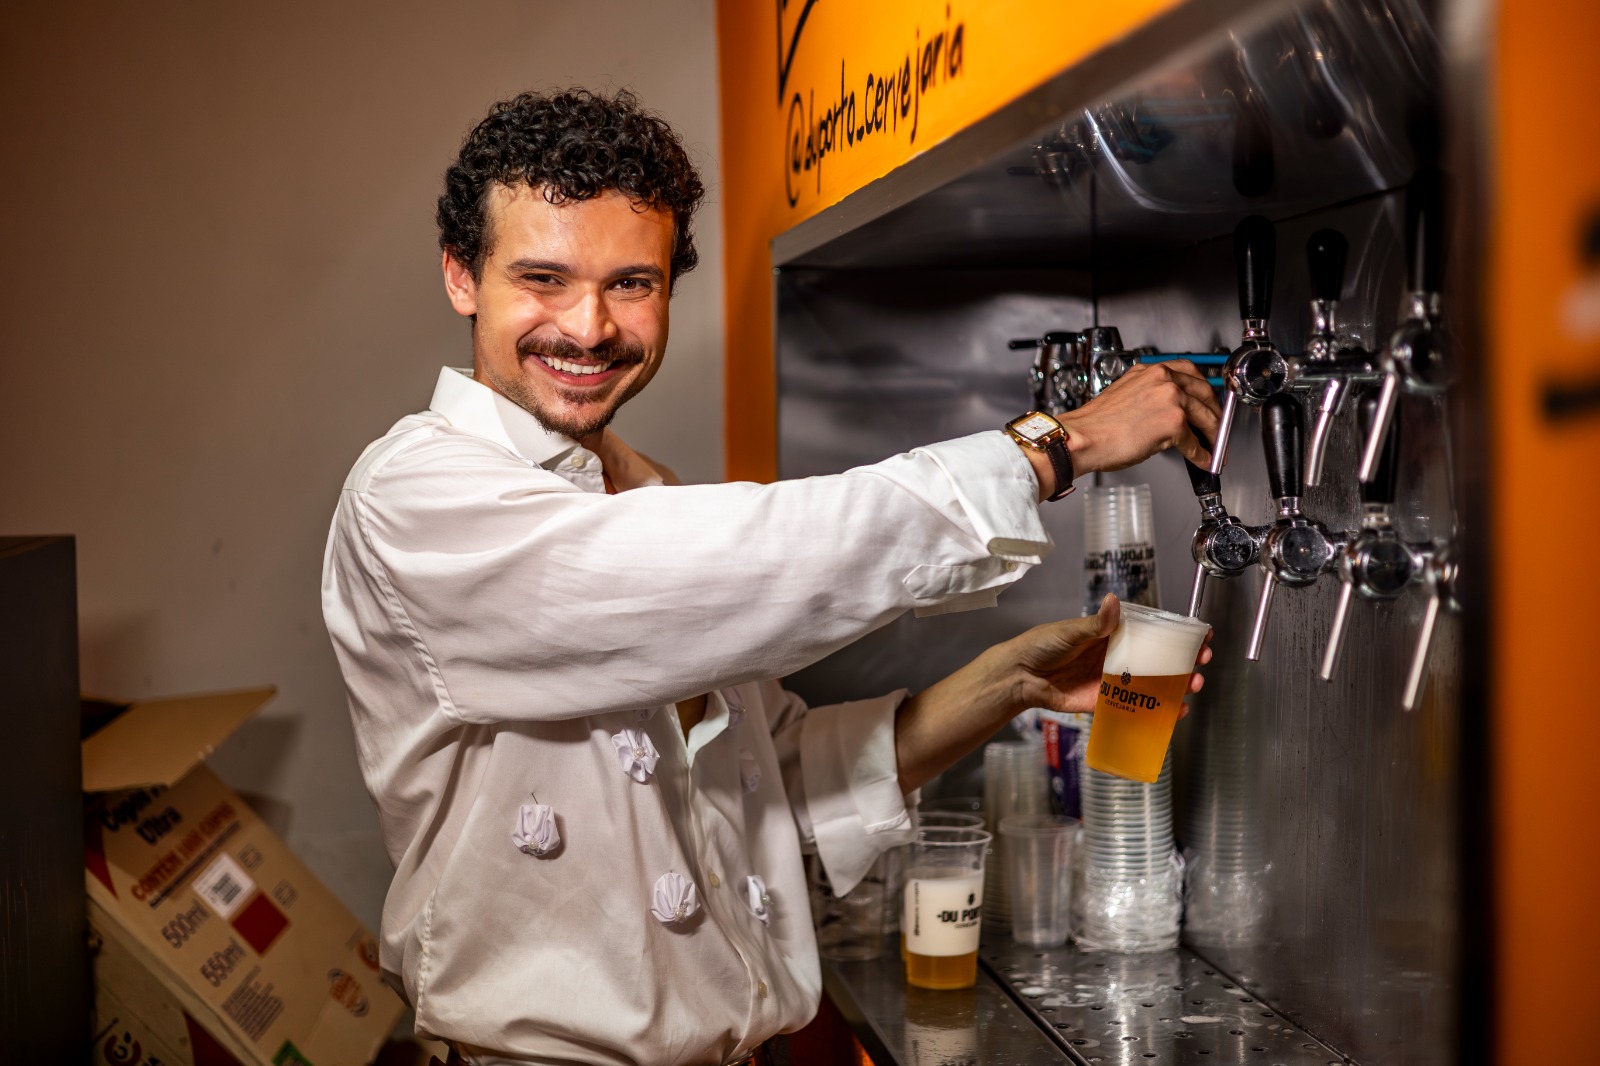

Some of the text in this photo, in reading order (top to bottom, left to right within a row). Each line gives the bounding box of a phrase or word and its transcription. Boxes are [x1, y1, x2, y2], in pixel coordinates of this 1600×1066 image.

[1105, 699, 1136, 713] CERVEJARIA
[1112, 686, 1156, 710] PORTO
[137, 806, 181, 844] Ultra
[161, 900, 210, 949] 500ml
[941, 910, 959, 922] DU
[201, 937, 246, 988] 550ml
